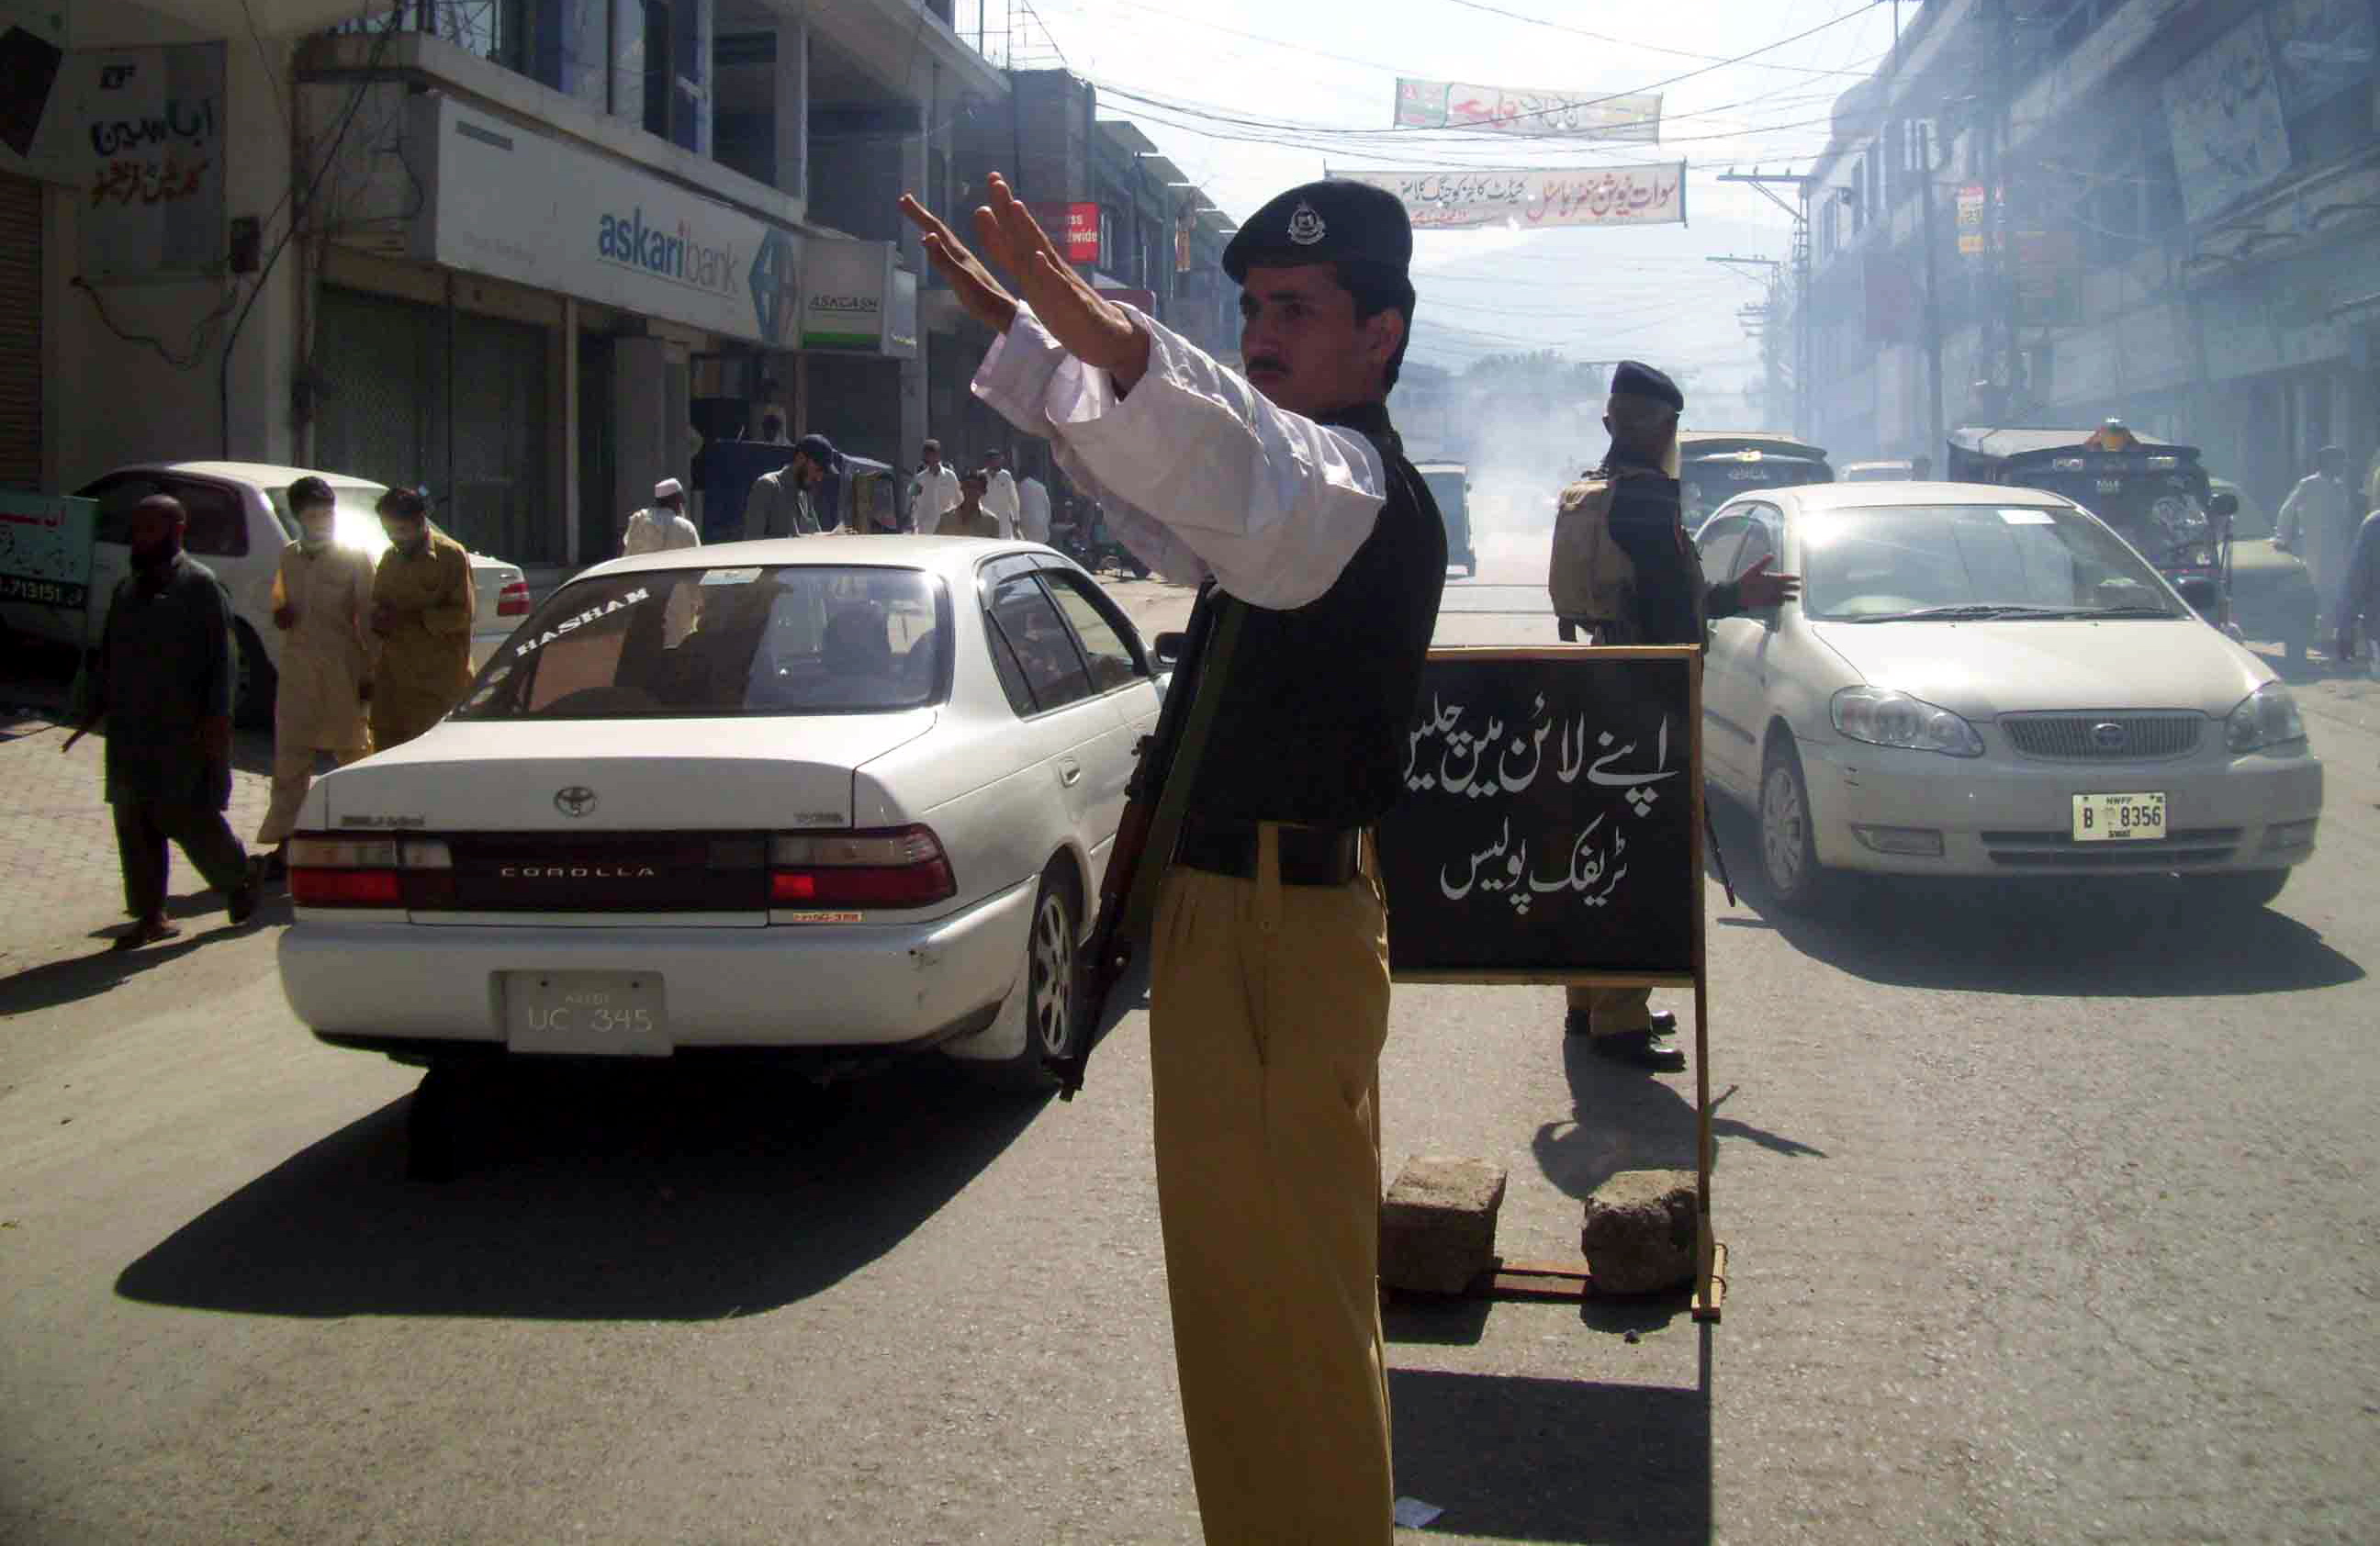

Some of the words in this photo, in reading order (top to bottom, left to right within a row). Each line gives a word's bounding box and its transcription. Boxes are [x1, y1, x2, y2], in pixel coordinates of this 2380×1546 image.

[1628, 172, 1678, 209] سوات
[514, 587, 650, 657] HASHAM
[2083, 807, 2094, 828] B
[2120, 805, 2161, 827] 8356
[501, 868, 654, 879] COROLLA
[1440, 816, 1532, 915] پولیس
[1529, 812, 1628, 907] ٹریفک
[590, 1008, 653, 1033] 345
